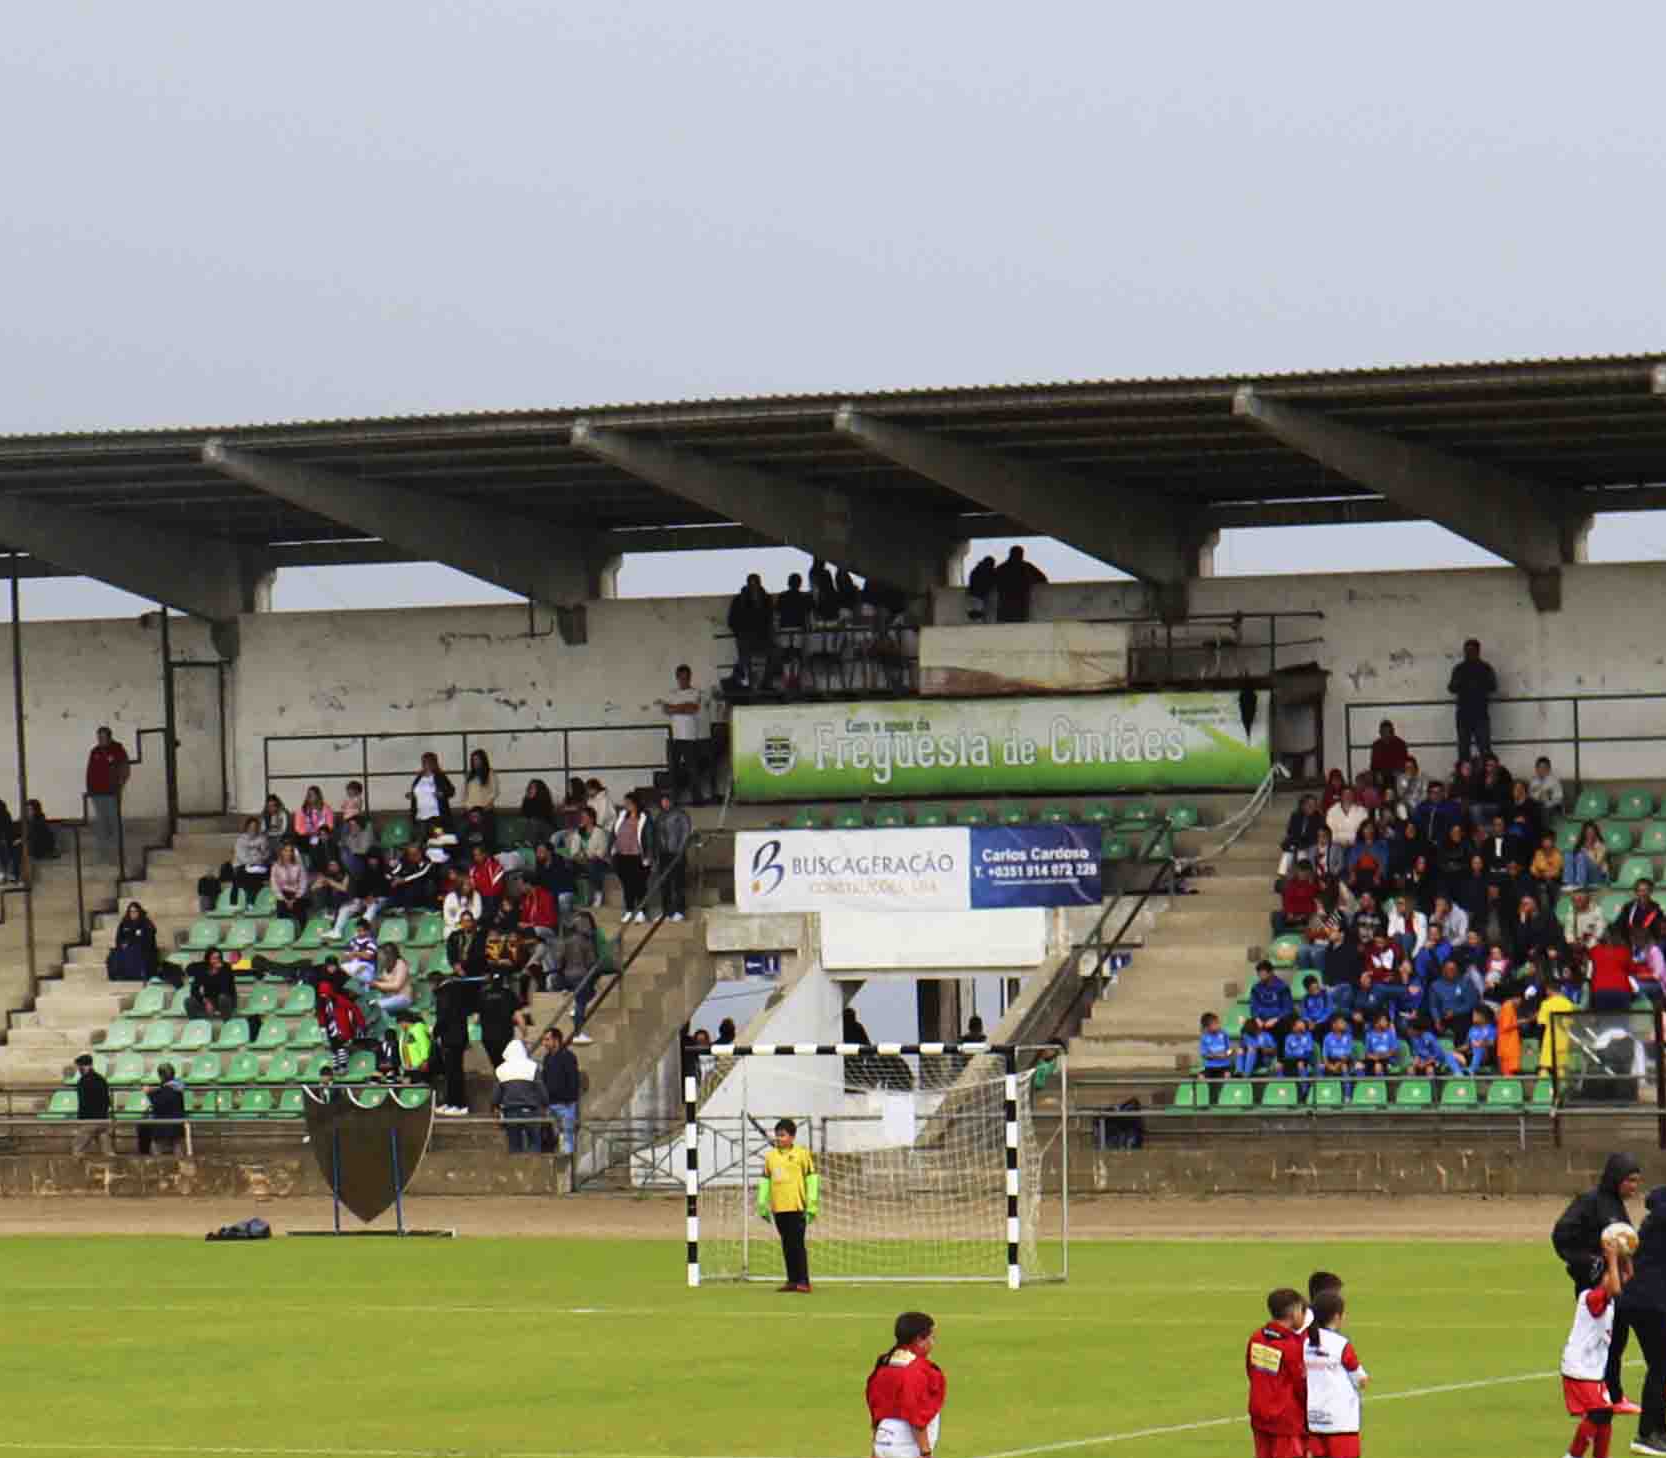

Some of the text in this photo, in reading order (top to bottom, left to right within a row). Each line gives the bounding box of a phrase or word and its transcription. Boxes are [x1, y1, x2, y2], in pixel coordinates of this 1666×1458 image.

[813, 713, 1185, 784] Freguesia de Cinfães
[981, 847, 1090, 863] Carlos Cardoso
